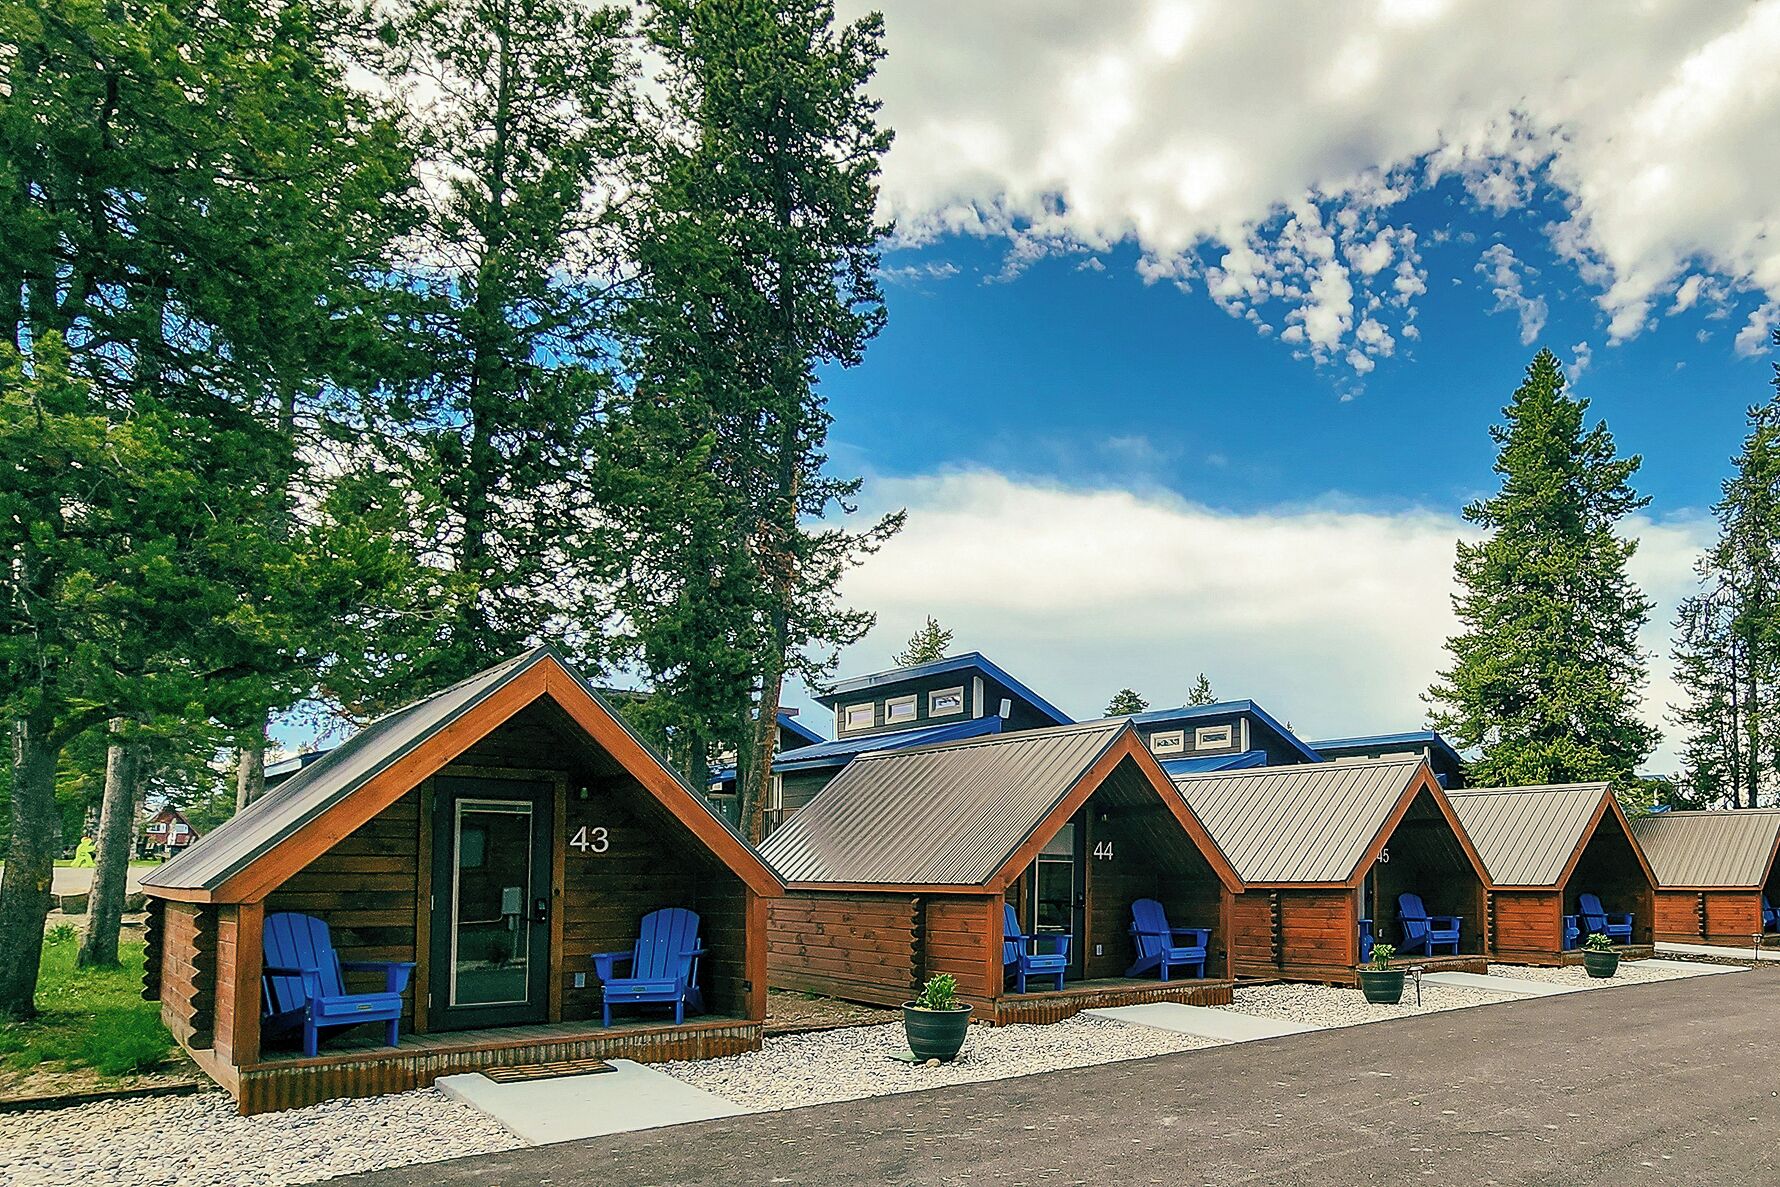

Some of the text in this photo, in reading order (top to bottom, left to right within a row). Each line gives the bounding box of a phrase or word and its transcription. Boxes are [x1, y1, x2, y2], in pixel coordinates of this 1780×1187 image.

[570, 826, 609, 853] 43
[1094, 841, 1113, 860] 44
[1376, 848, 1390, 863] 45
